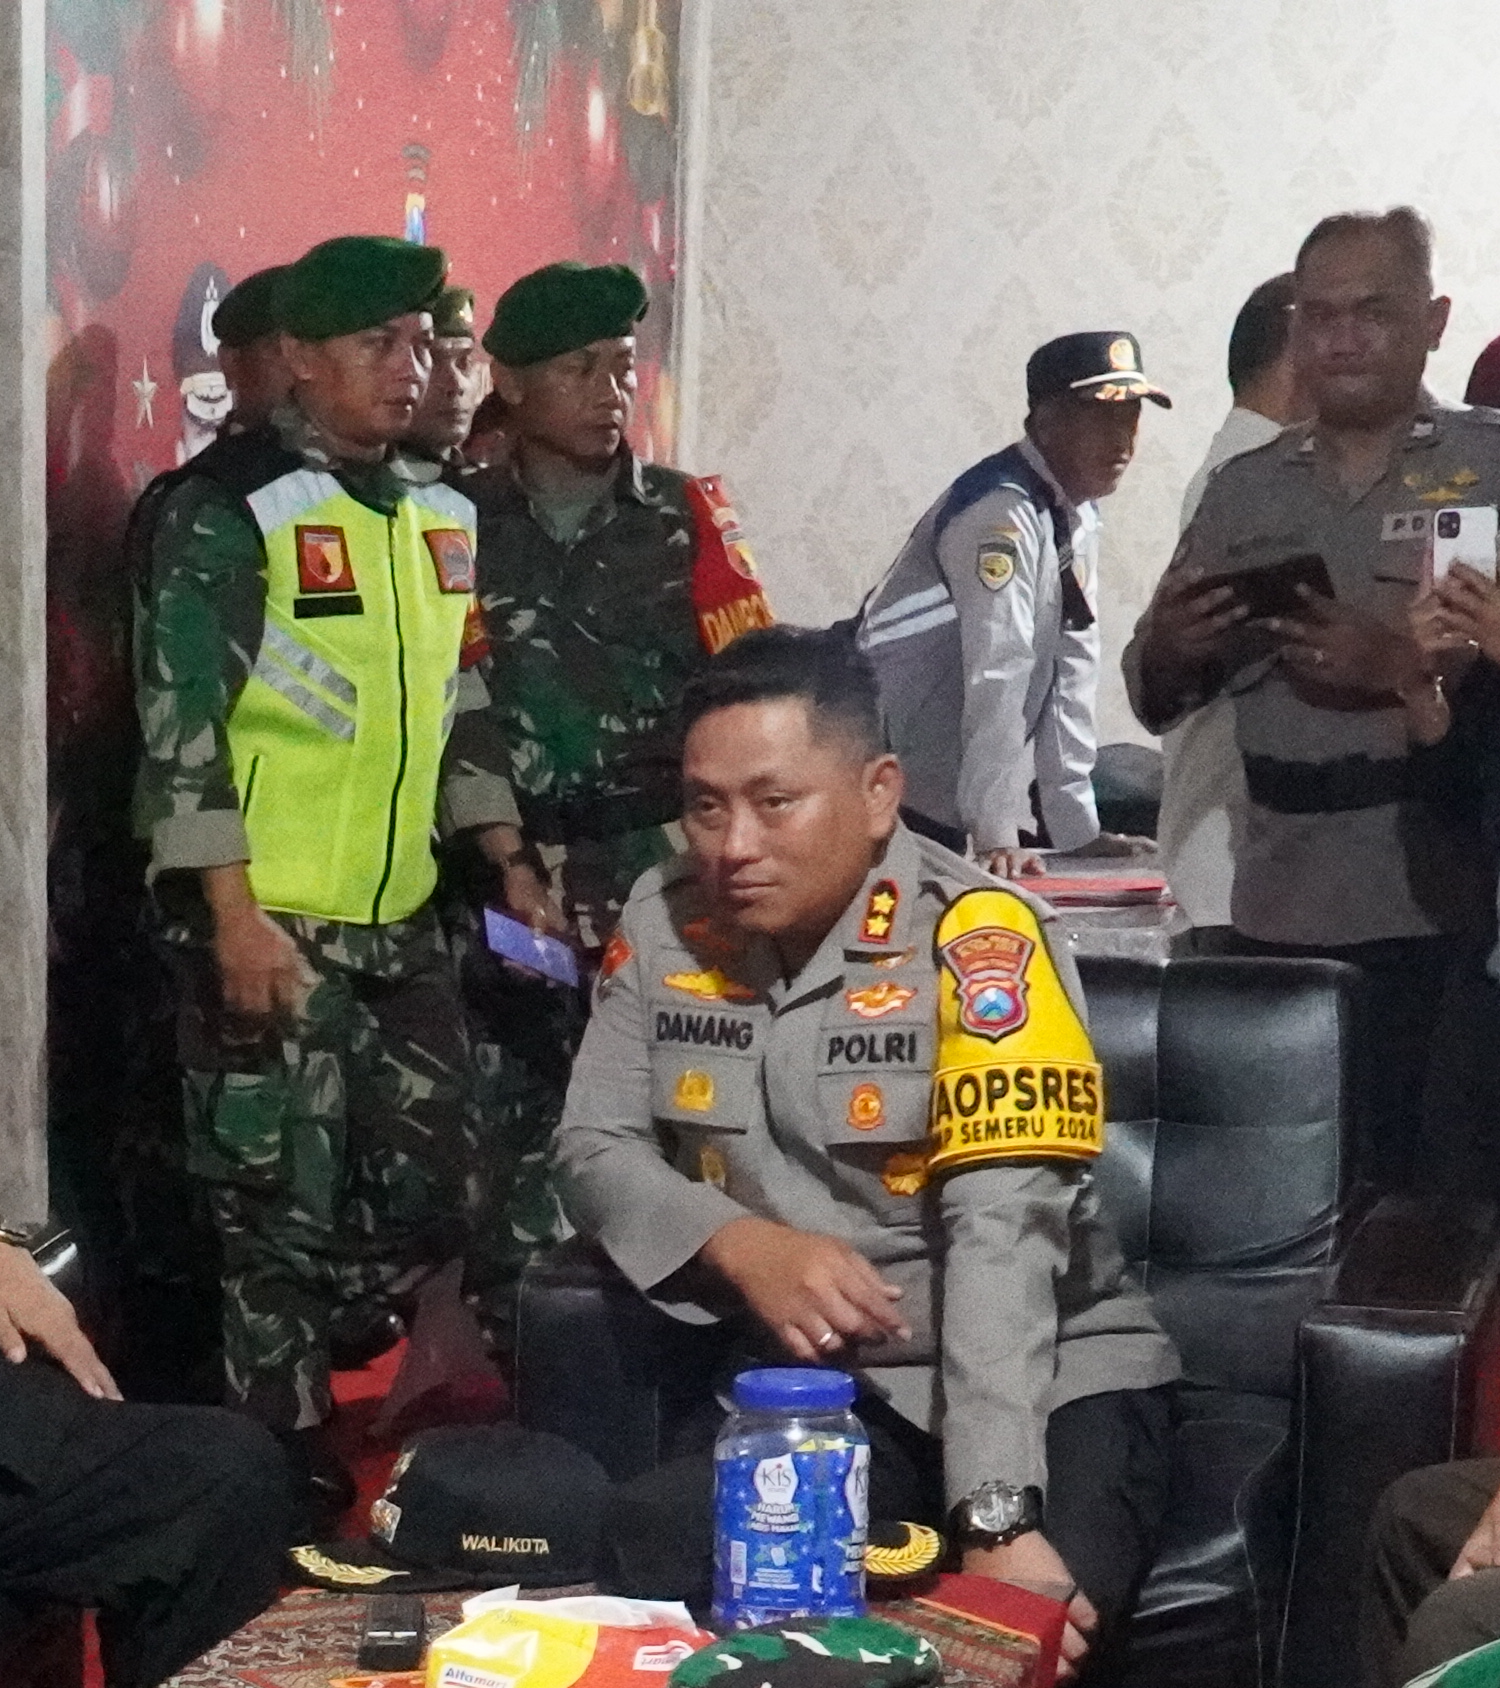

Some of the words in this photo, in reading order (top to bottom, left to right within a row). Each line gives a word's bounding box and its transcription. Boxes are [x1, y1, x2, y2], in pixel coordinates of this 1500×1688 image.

[656, 1011, 754, 1051] DANANG
[827, 1030, 917, 1066] POLRI
[960, 1115, 1045, 1145] SEMERU
[1055, 1116, 1097, 1143] 2024
[462, 1533, 550, 1554] WALIKOTA
